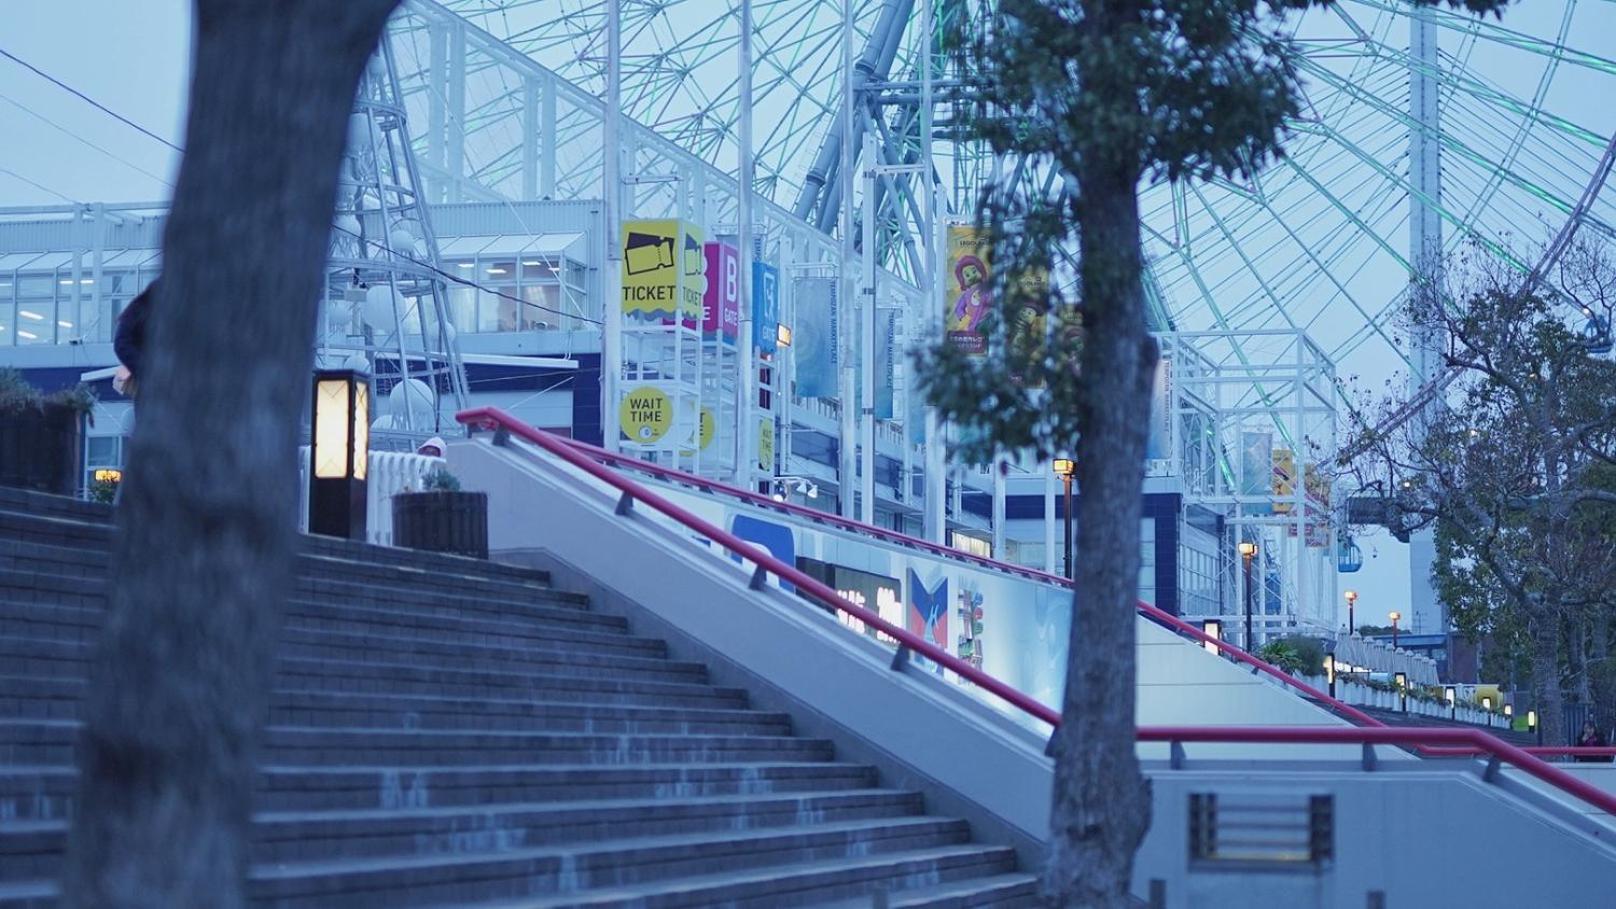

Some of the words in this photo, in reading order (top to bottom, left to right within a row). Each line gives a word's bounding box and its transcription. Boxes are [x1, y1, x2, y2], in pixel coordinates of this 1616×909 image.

[726, 255, 737, 302] B
[622, 285, 676, 301] TICKET
[630, 398, 663, 409] WAIT
[630, 411, 662, 422] TIME
